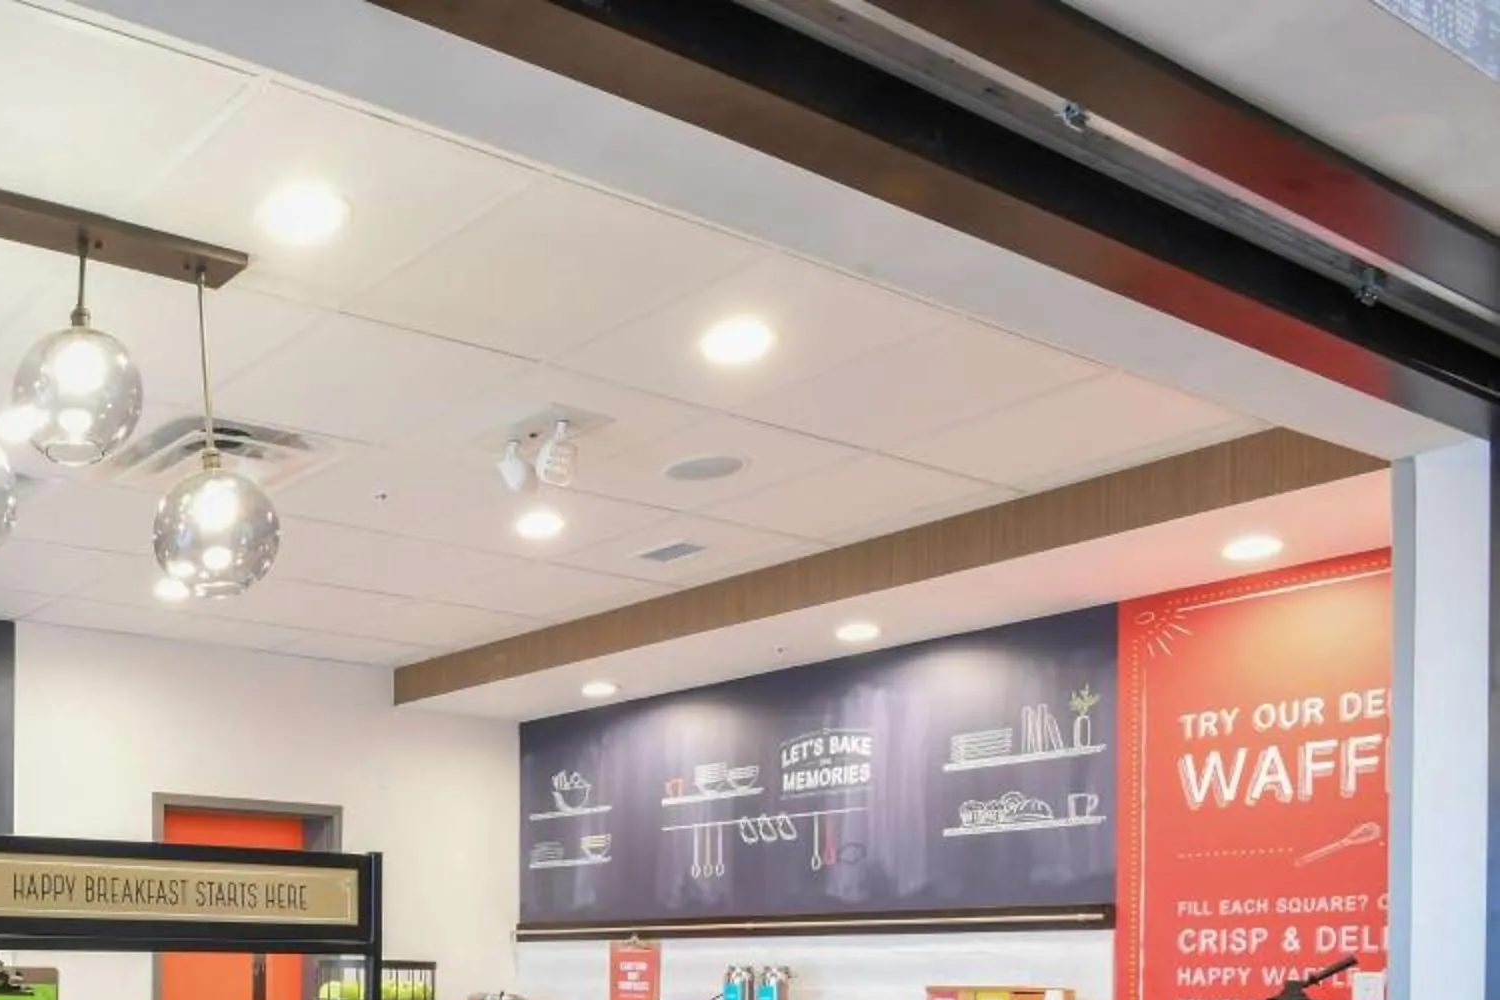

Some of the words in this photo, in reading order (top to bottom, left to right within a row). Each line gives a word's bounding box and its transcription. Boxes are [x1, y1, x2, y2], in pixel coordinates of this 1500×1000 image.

[1177, 707, 1240, 740] TRY
[1252, 697, 1326, 733] OUR
[1338, 688, 1392, 722] DE
[781, 738, 824, 769] LET'S
[828, 735, 873, 756] BAKE
[782, 763, 871, 793] MEMORIES
[1177, 733, 1390, 811] WAFF
[12, 872, 77, 902] HAPPY
[85, 874, 189, 907] BREAKFAST
[195, 880, 259, 910] STARTS
[264, 882, 309, 912] HERE
[1177, 900, 1213, 918] FILL
[1219, 899, 1269, 915] EACH
[1275, 894, 1369, 914] SQUARE?
[1177, 926, 1269, 955] CRISP
[1282, 926, 1301, 953] &
[1176, 966, 1252, 987] HAPPY
